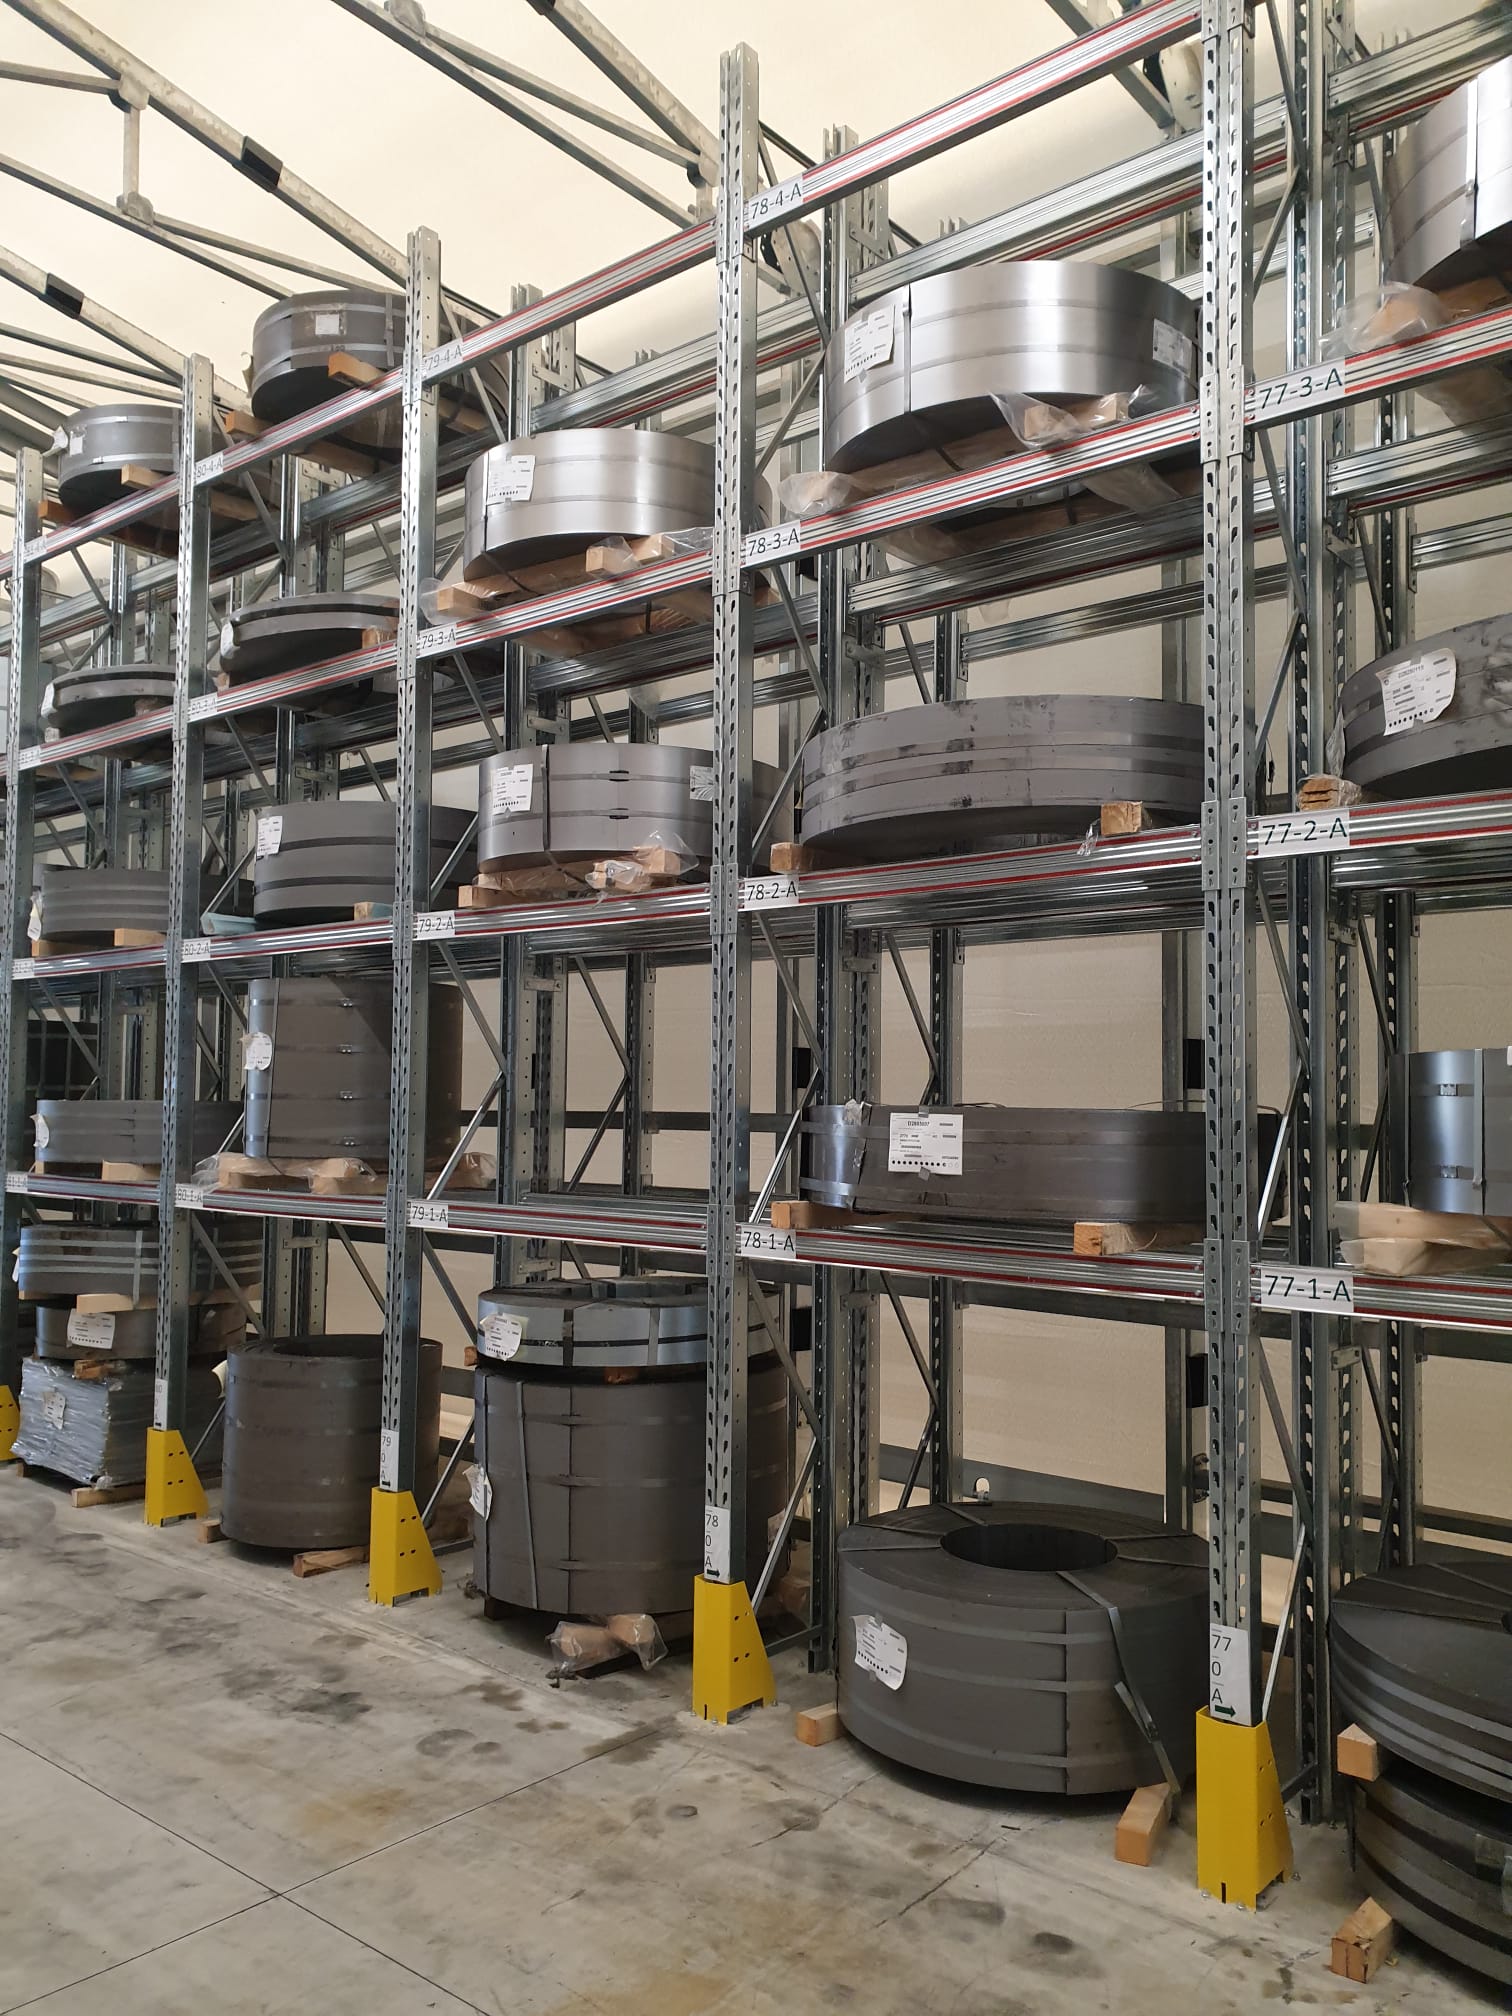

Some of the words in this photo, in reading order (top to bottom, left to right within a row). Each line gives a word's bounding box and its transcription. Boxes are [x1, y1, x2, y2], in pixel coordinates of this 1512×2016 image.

[751, 183, 801, 219] 78-4-A
[425, 345, 462, 370] 79-4-A
[1259, 368, 1343, 409] 77-3-A
[748, 528, 799, 556] 78-3-A
[422, 628, 456, 649] 79-3-A
[1262, 817, 1347, 845] 77-2-A
[746, 881, 797, 901] 78-2-A
[419, 916, 454, 932] 79-2-A
[412, 1205, 447, 1222] 79-1-A
[743, 1231, 795, 1252] 78-1-A
[1265, 1275, 1351, 1302] 77-1-A
[382, 1435, 391, 1447] 79
[705, 1513, 719, 1528] 78
[705, 1534, 712, 1547] 0
[704, 1555, 713, 1568] A
[1211, 1634, 1232, 1652] 77
[1211, 1661, 1221, 1677] 0
[1211, 1688, 1223, 1704] A
